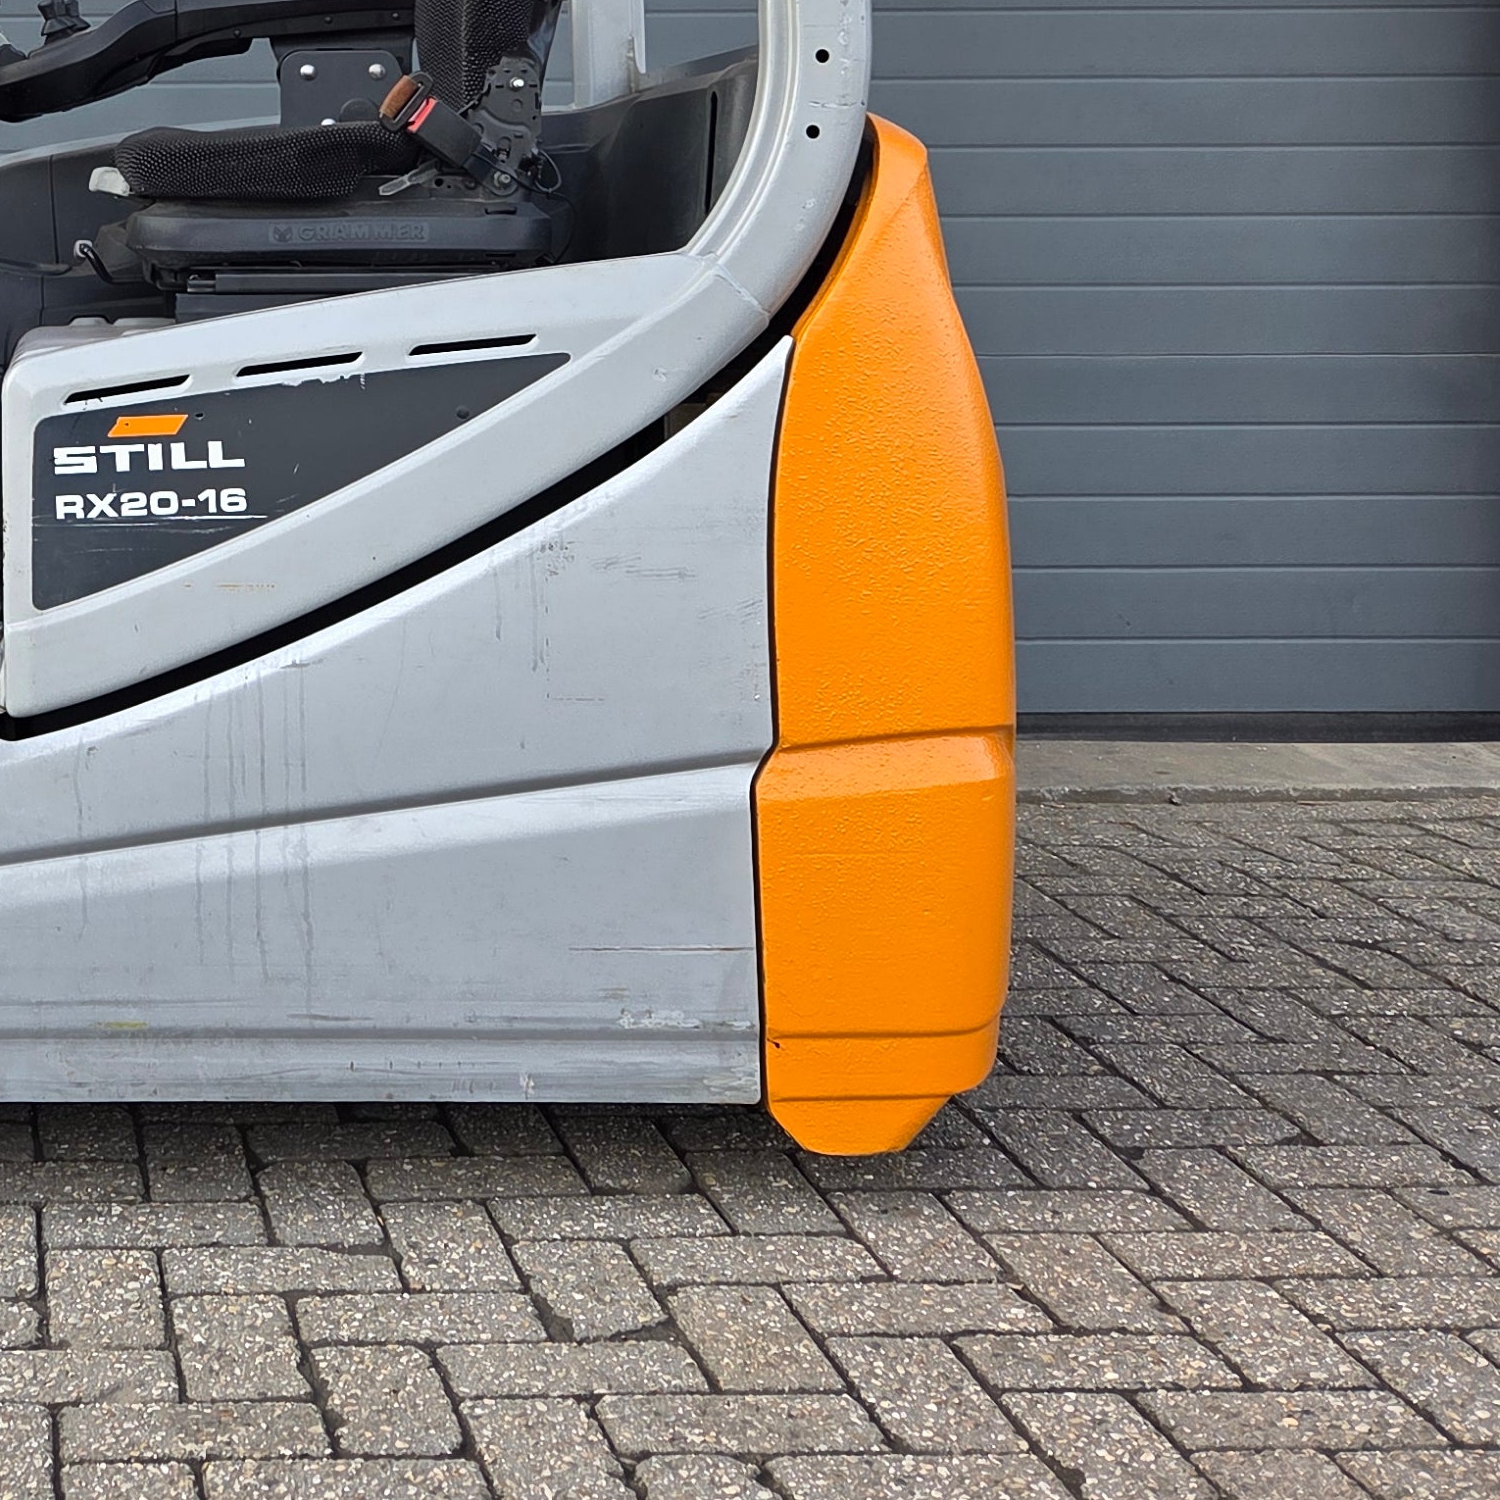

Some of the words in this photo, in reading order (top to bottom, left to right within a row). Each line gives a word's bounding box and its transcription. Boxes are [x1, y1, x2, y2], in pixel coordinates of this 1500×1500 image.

[298, 223, 426, 242] GRAMMER
[53, 440, 246, 475] STILL
[55, 487, 248, 520] RX20-16
